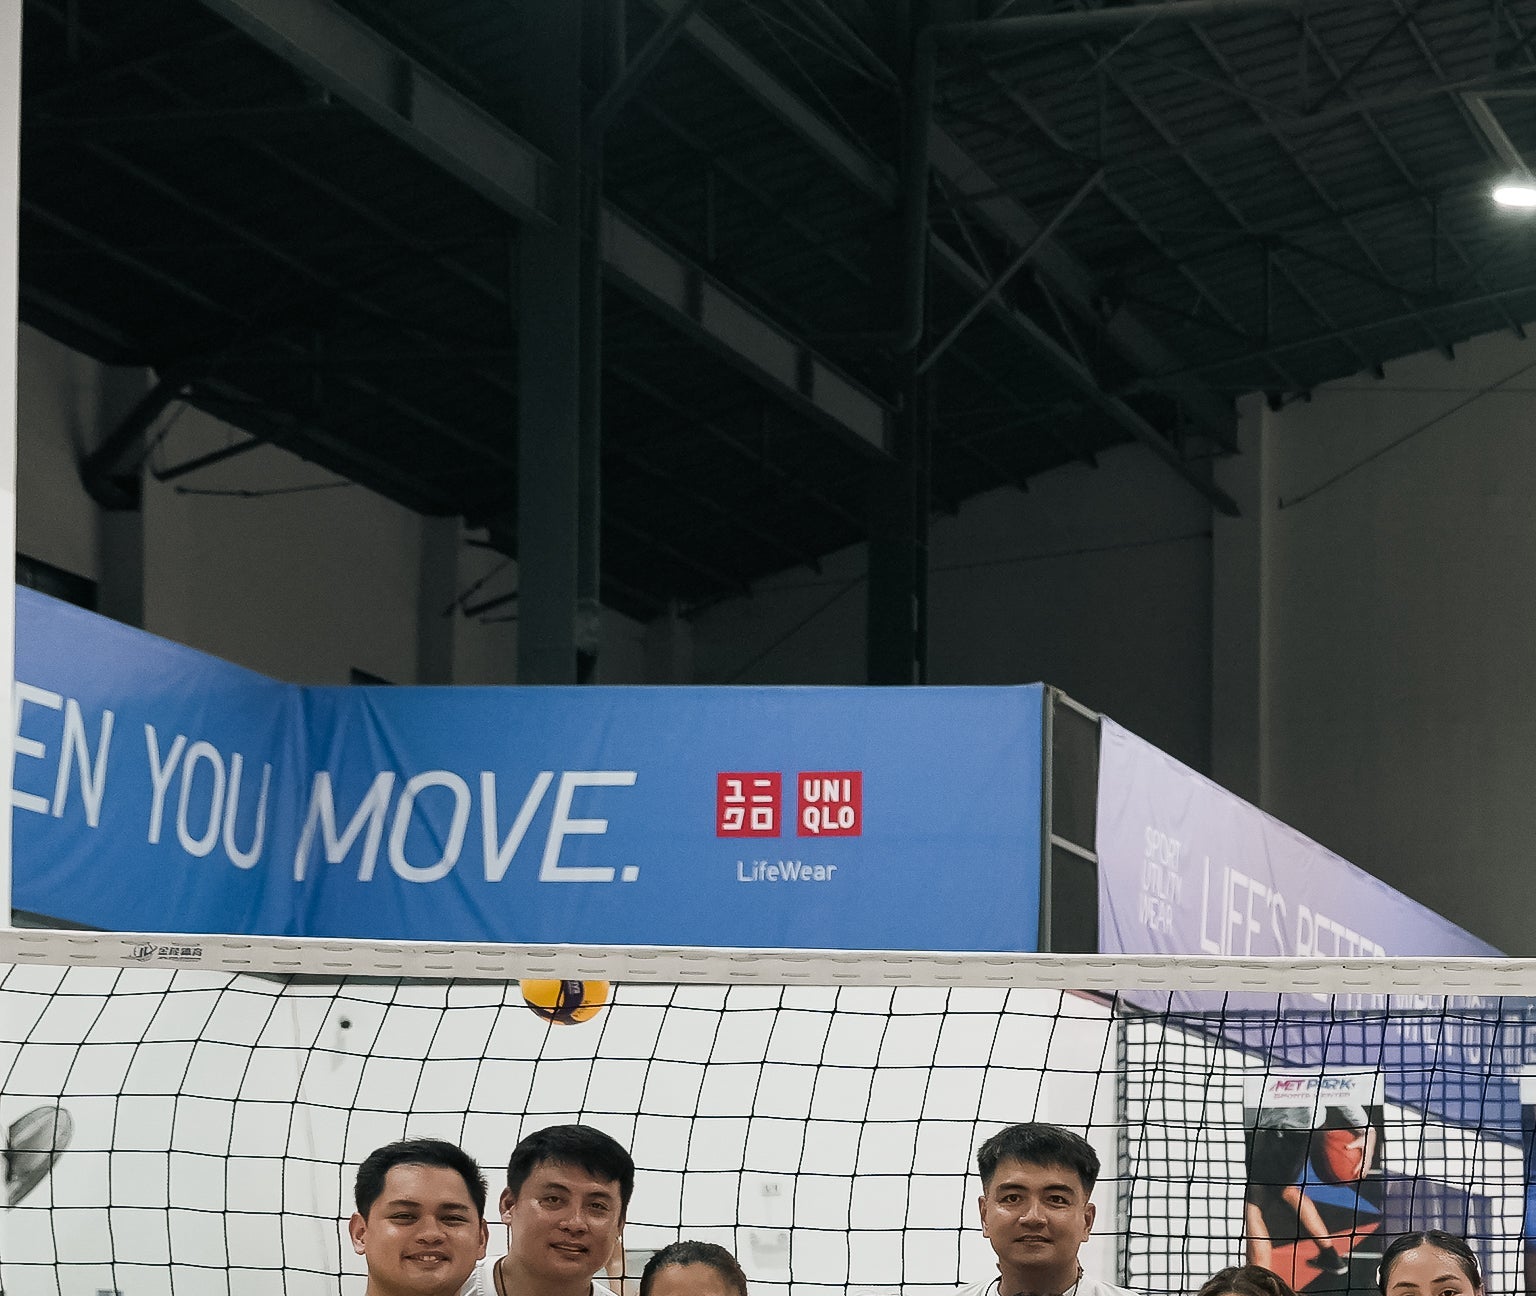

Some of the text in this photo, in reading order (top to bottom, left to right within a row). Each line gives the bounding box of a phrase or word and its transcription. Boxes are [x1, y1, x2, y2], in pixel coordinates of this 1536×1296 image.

[144, 723, 272, 869] YOU
[294, 771, 639, 882] MOVE.
[803, 779, 851, 803] UNI
[802, 806, 855, 834] QLO
[736, 860, 838, 882] LifeWear
[1275, 1080, 1305, 1091] MET
